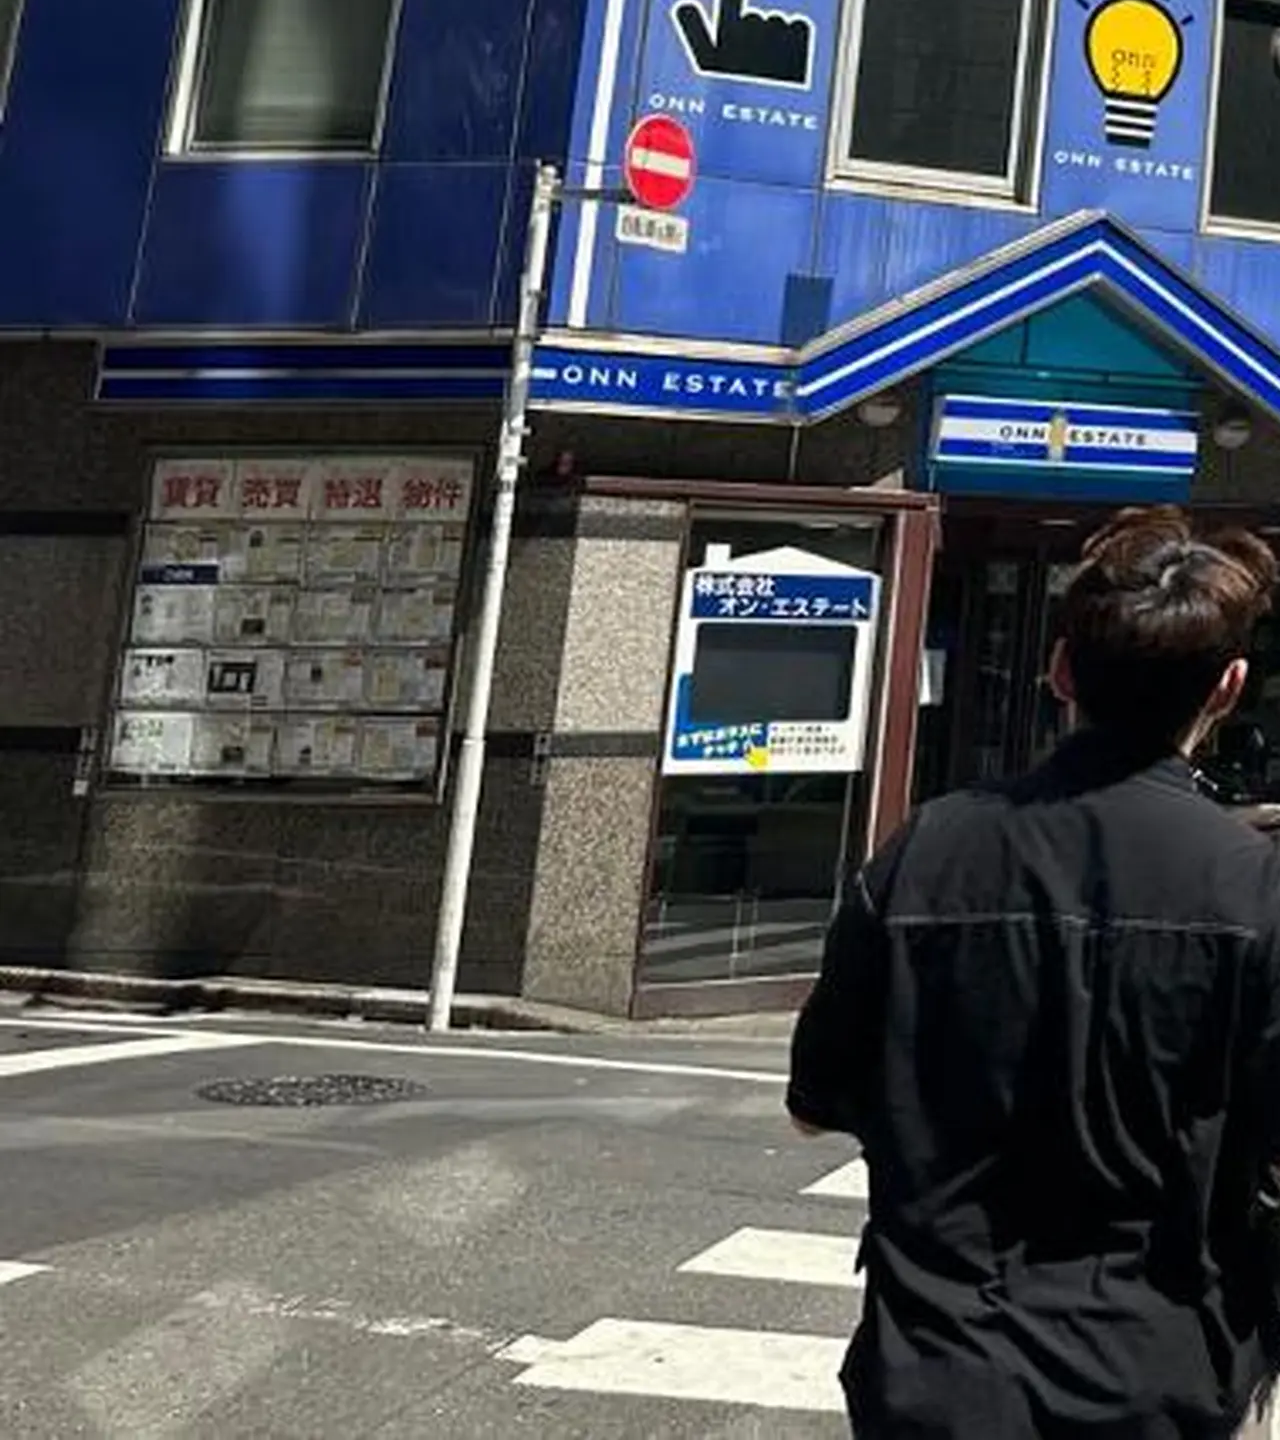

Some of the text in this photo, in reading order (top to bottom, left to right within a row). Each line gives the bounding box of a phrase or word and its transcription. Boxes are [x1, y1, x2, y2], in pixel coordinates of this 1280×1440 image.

[649, 92, 819, 130] ONN ESTATE
[1054, 150, 1194, 181] ONN ESTATE
[561, 364, 792, 398] ONN ESTATE
[1000, 425, 1146, 446] ONN ESTATE
[695, 575, 776, 597] 株式会社
[717, 597, 870, 617] オン・エステート
